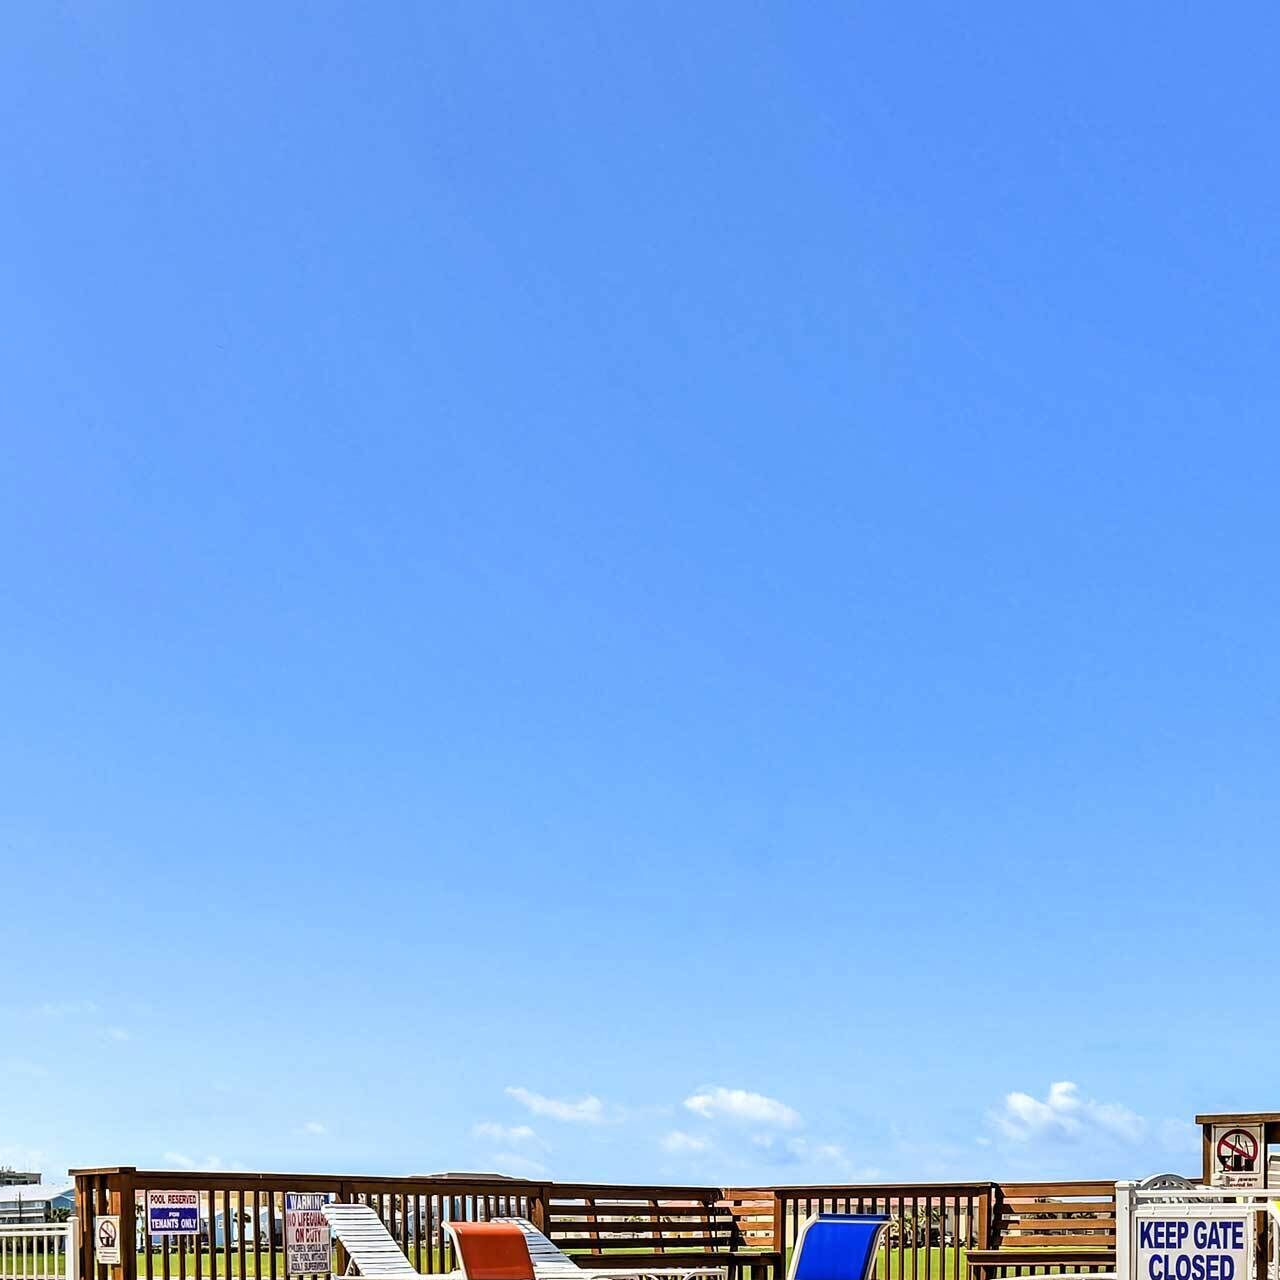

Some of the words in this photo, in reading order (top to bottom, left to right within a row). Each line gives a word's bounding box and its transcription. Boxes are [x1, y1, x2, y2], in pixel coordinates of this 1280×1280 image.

[151, 1195, 165, 1204] POOL
[168, 1195, 196, 1204] RESERVED
[152, 1219, 178, 1228] TENANTS
[181, 1219, 196, 1228] ONLY
[287, 1213, 296, 1227] NO
[296, 1229, 304, 1243] ON
[306, 1229, 320, 1243] DUTY
[1140, 1222, 1189, 1249] KEEP
[1194, 1221, 1244, 1249] GATE
